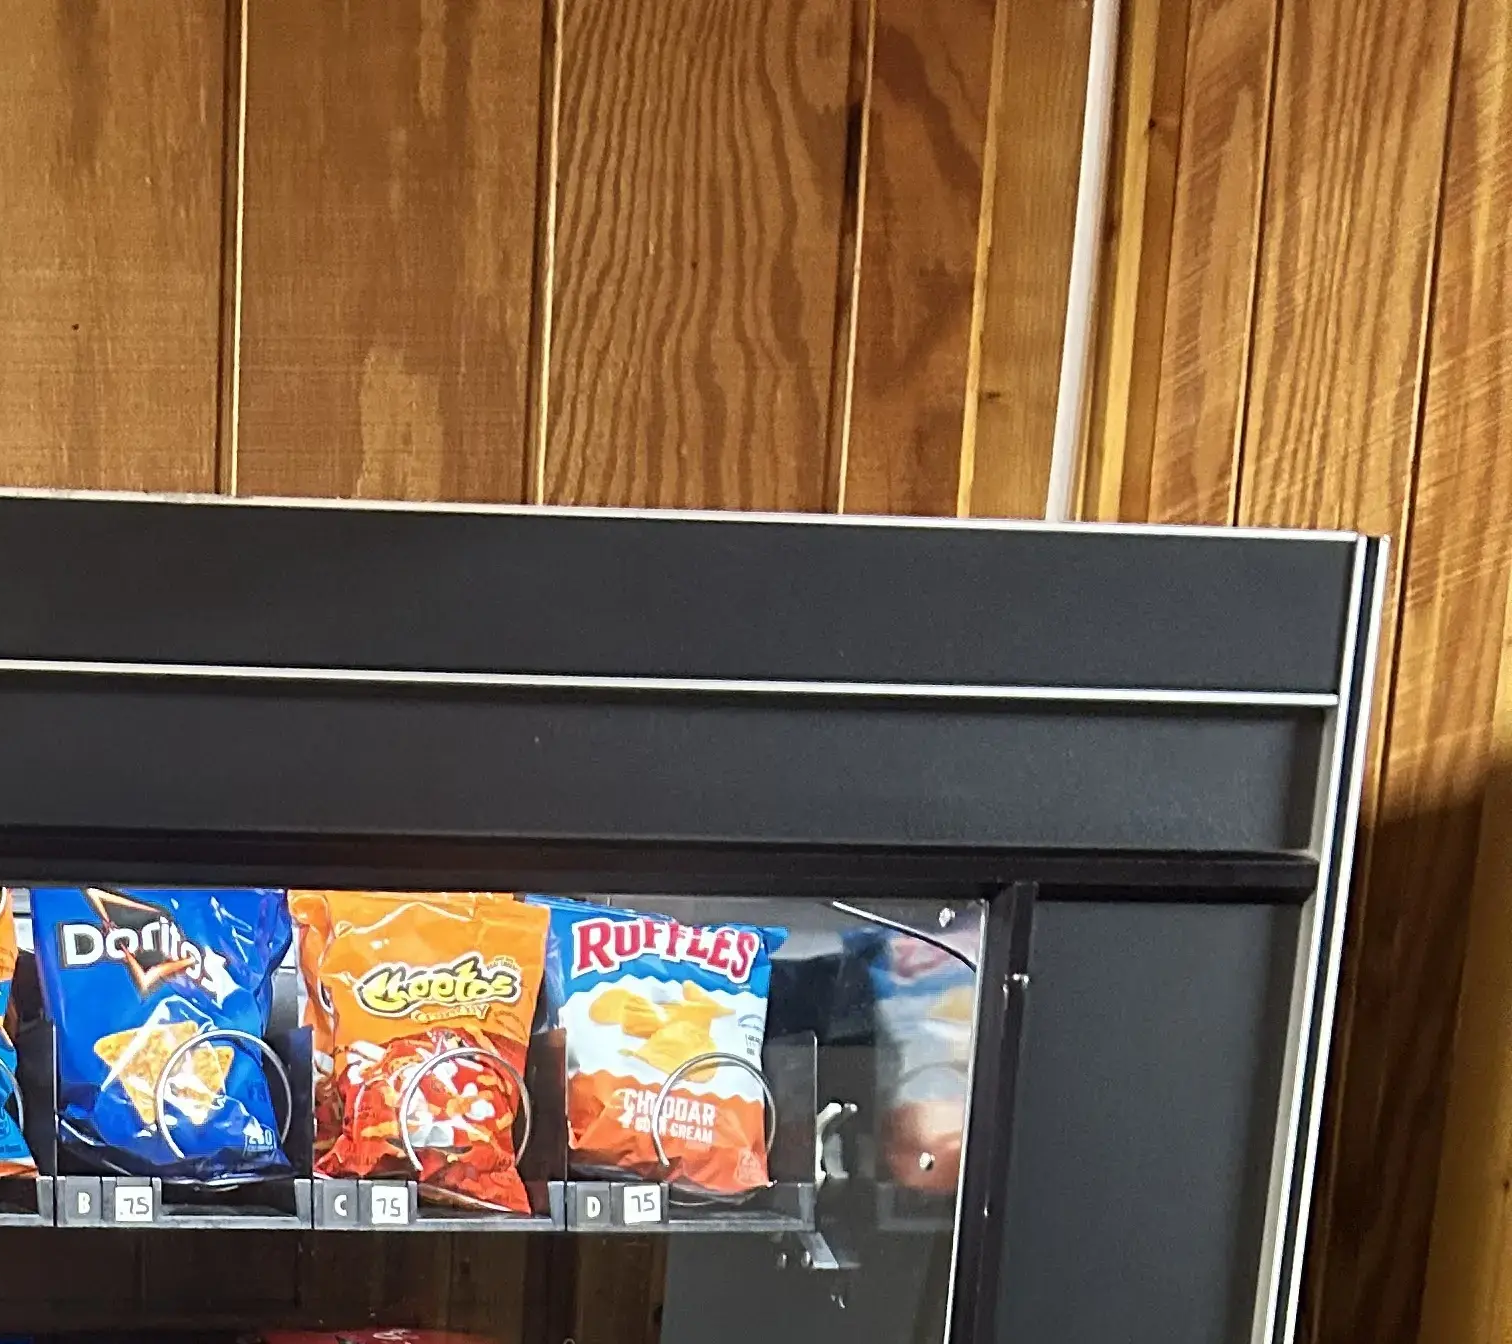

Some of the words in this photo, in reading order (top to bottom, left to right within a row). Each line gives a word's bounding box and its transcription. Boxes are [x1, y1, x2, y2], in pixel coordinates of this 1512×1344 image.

[578, 920, 755, 979] RUFFLES
[61, 916, 240, 1006] Doritos
[670, 1123, 714, 1144] CREAM
[78, 1192, 90, 1214] B
[334, 1194, 347, 1217] C
[586, 1196, 601, 1218] D
